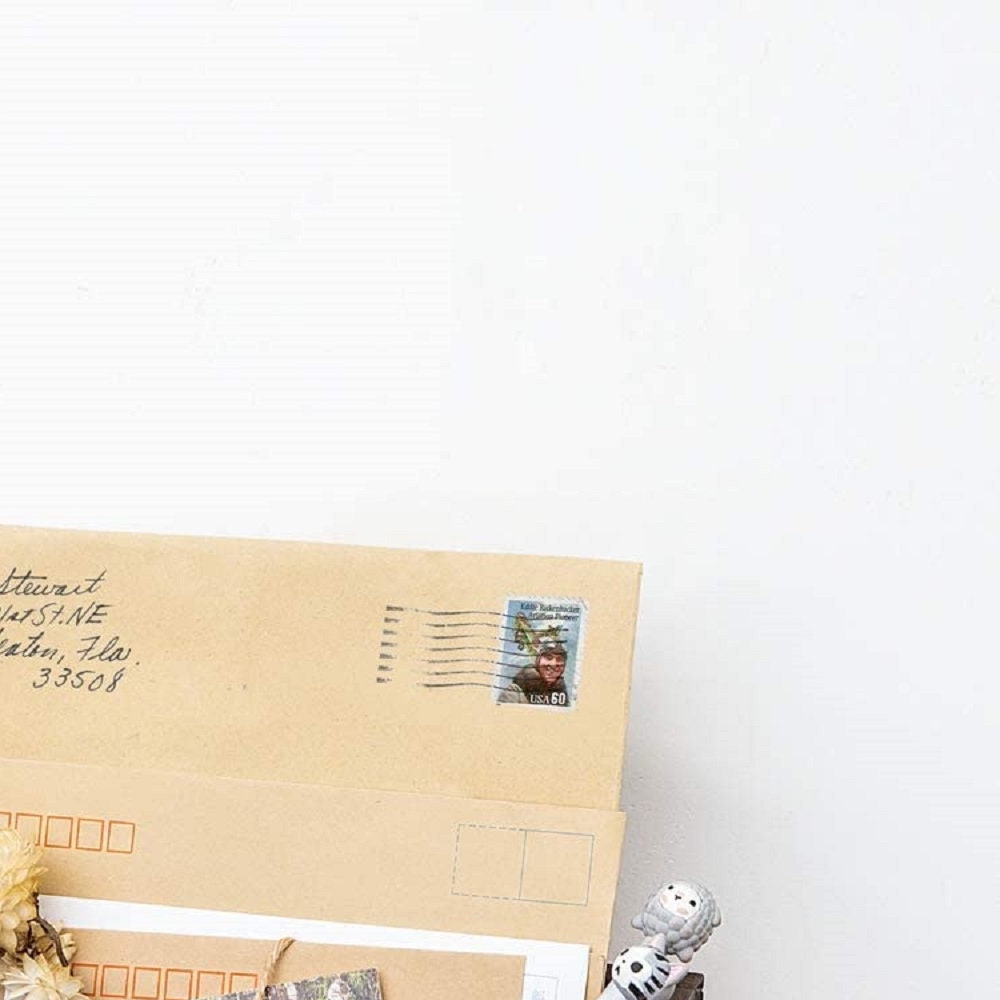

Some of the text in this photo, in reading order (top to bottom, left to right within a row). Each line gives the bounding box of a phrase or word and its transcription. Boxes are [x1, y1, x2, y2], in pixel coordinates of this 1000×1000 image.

[32, 667, 126, 693] 33508
[530, 691, 566, 705] USA 60
